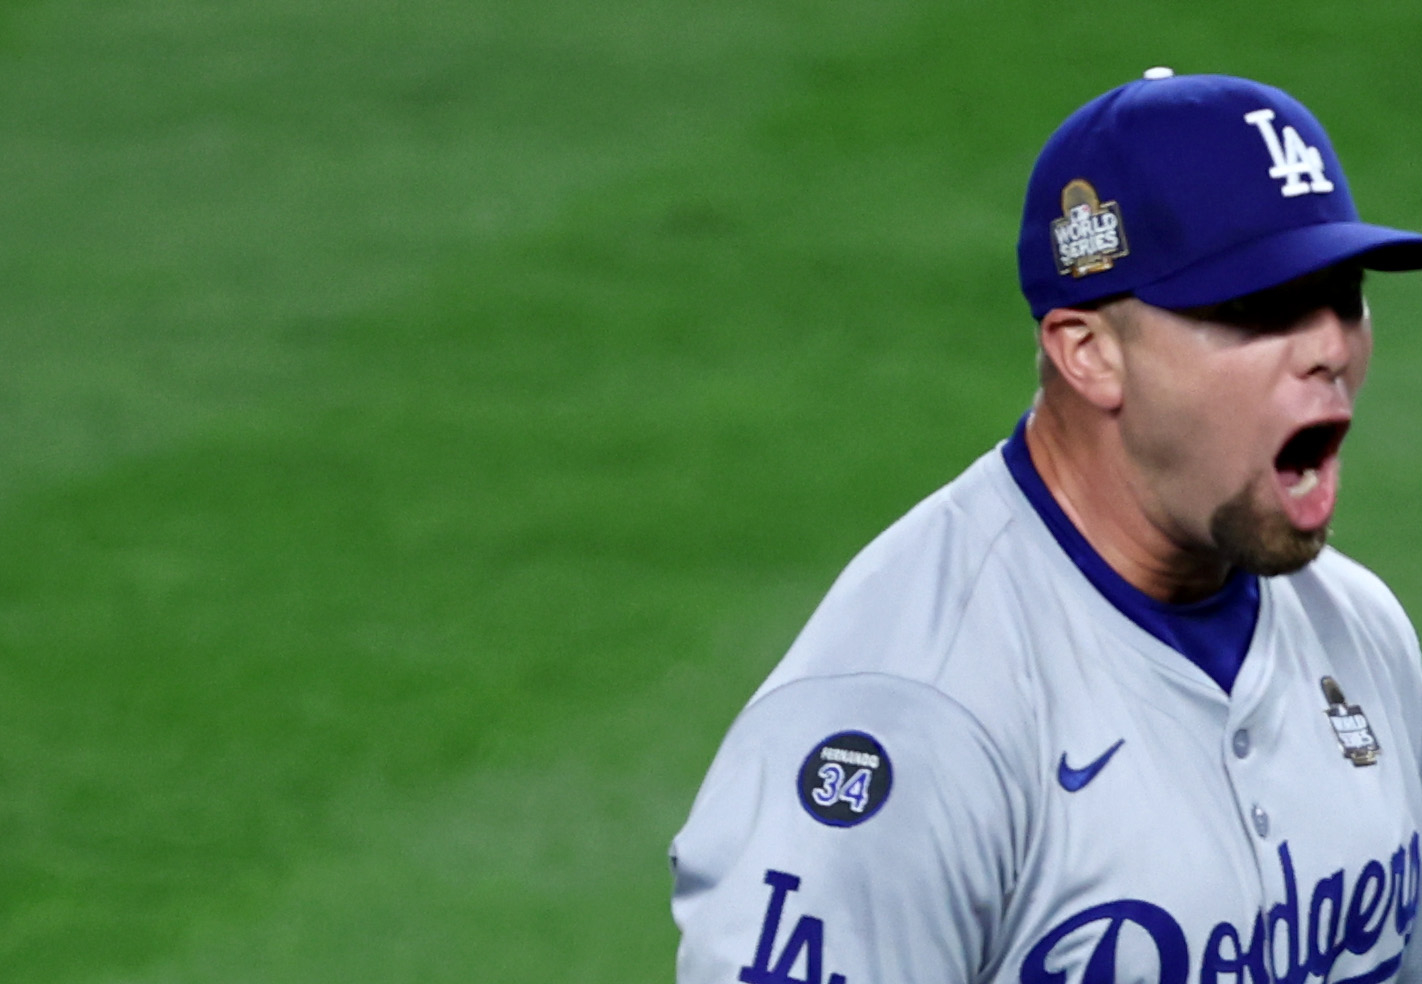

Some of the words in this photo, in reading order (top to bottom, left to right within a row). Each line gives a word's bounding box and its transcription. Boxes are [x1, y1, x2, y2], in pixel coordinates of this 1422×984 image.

[1244, 108, 1334, 197] LA
[1054, 212, 1118, 244] WORLD
[1059, 230, 1119, 266] SERIES
[812, 762, 872, 813] 34
